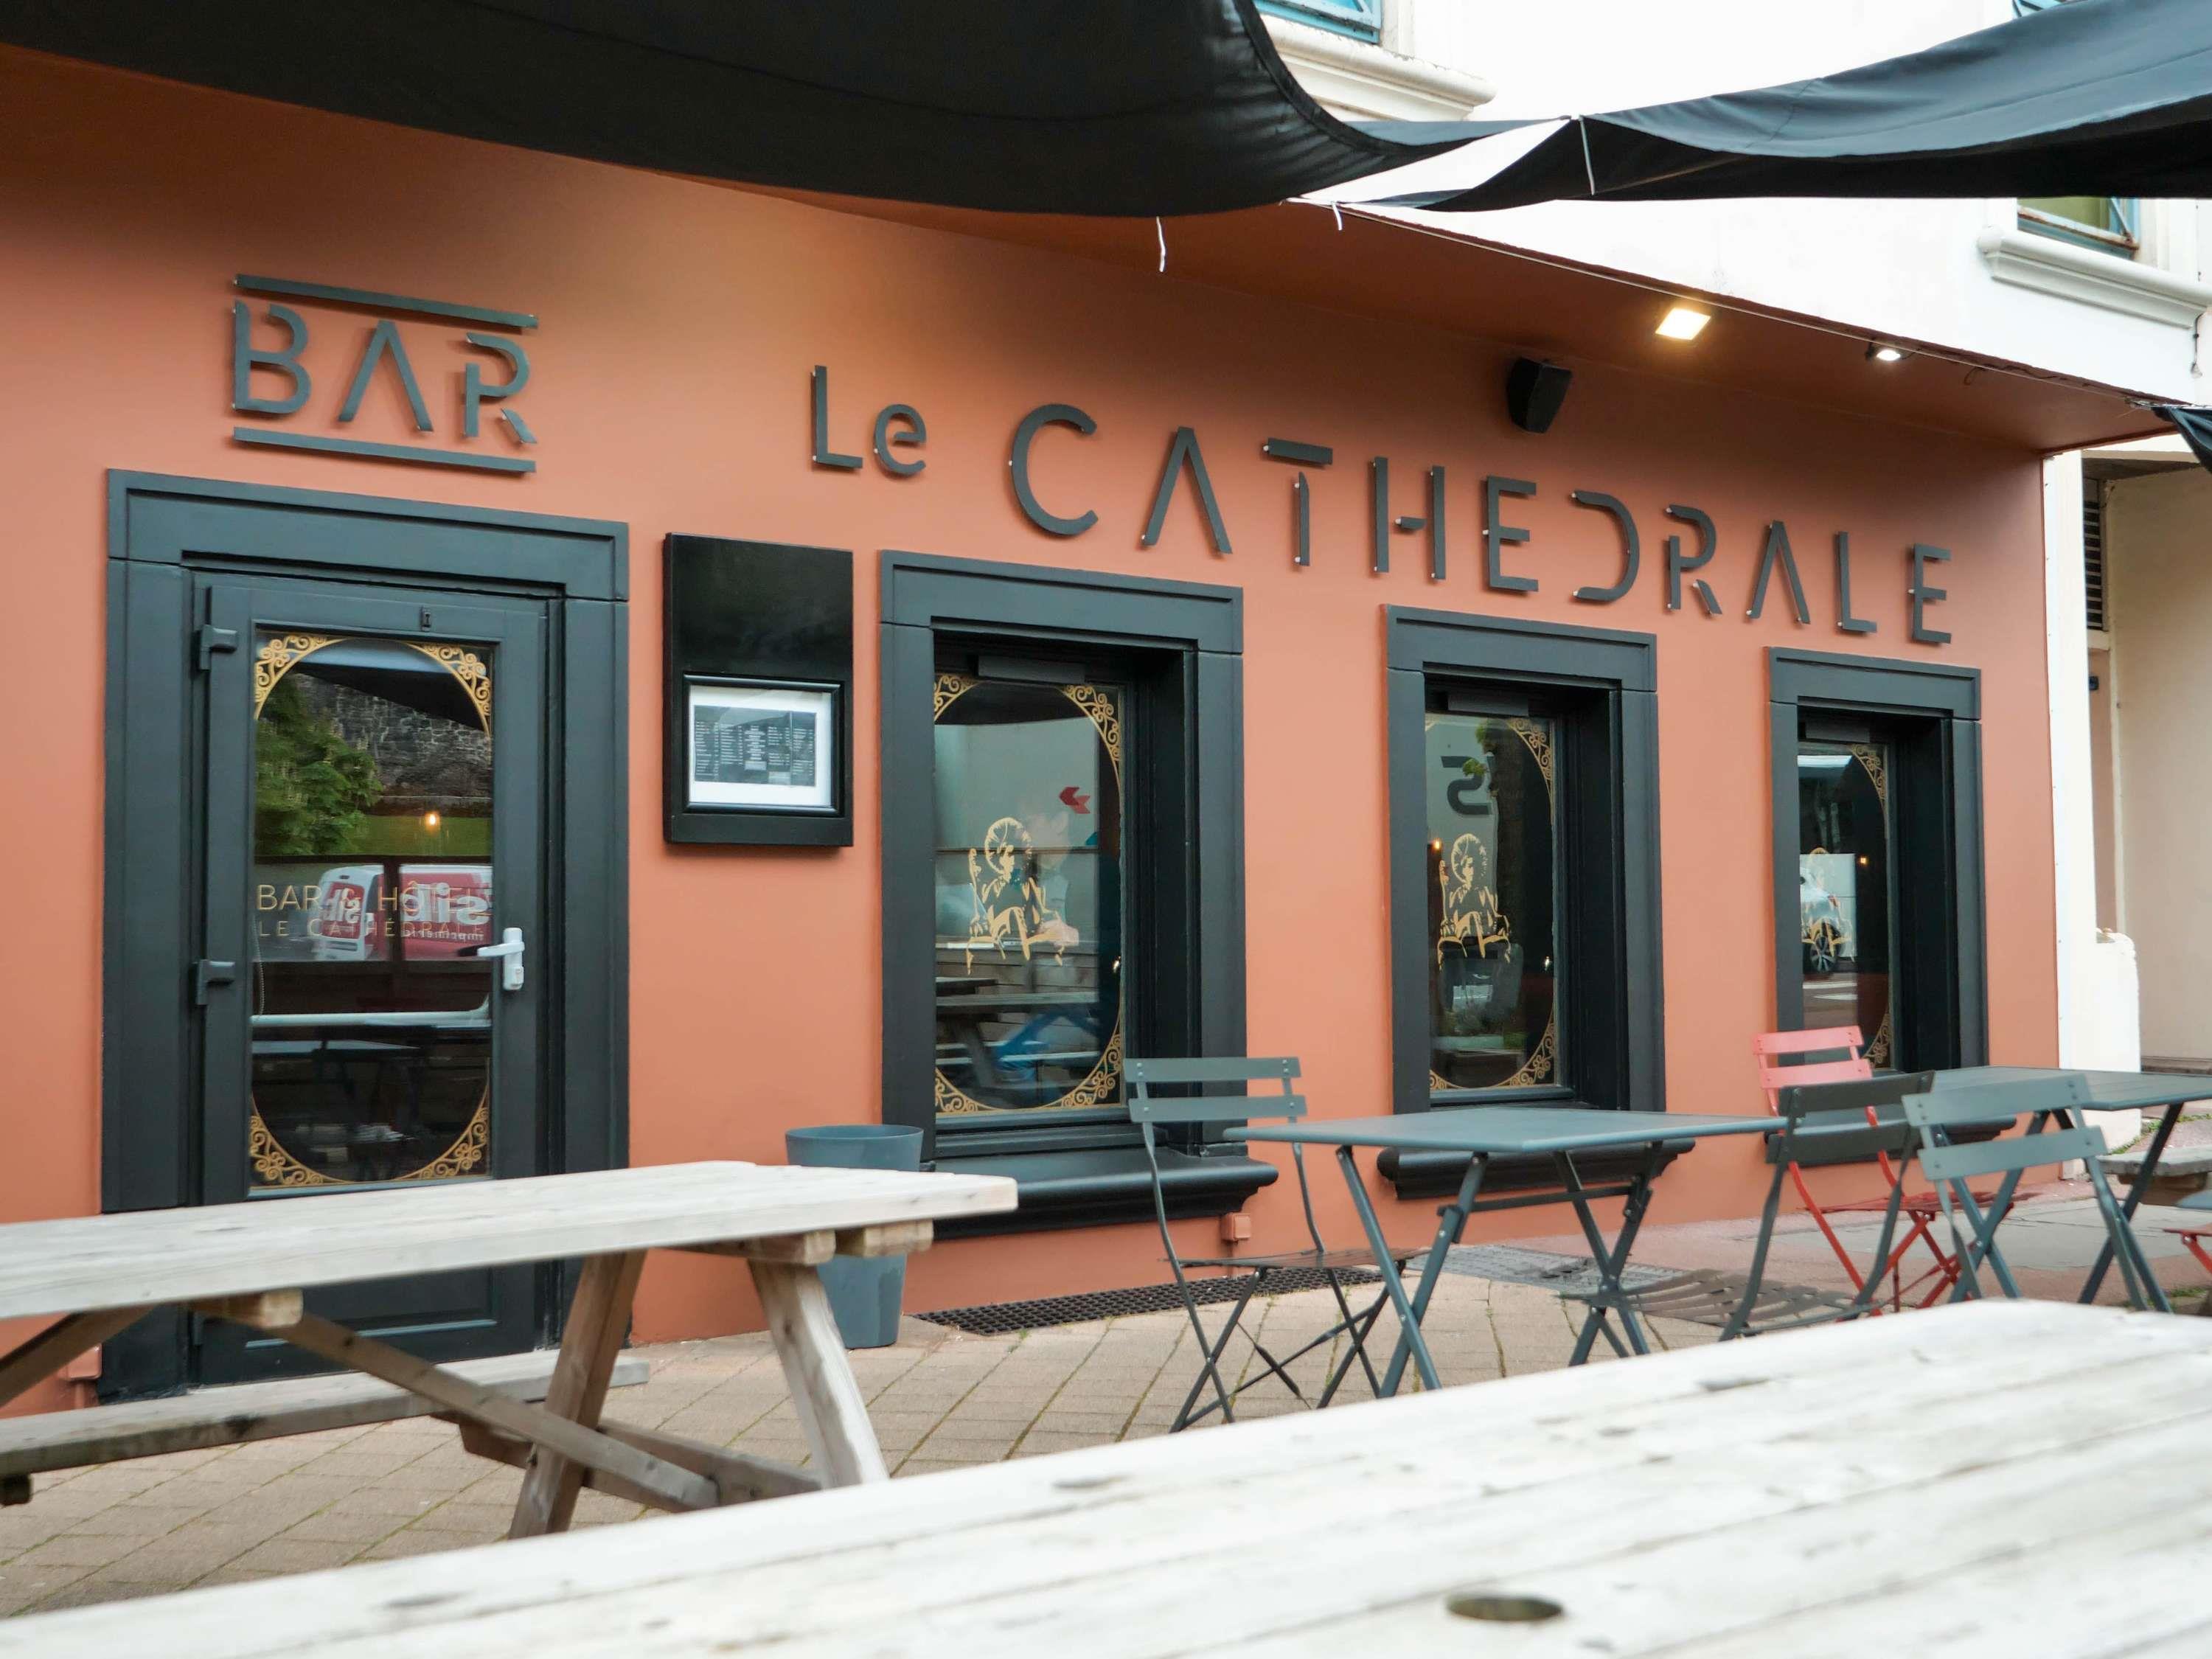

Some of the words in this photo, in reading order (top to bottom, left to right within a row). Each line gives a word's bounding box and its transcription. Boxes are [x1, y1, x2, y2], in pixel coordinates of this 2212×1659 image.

[233, 300, 538, 444] BAR
[811, 364, 927, 476] Le
[1010, 403, 1952, 644] CATHEDRALE
[258, 884, 322, 911] BAR
[259, 920, 290, 936] LE
